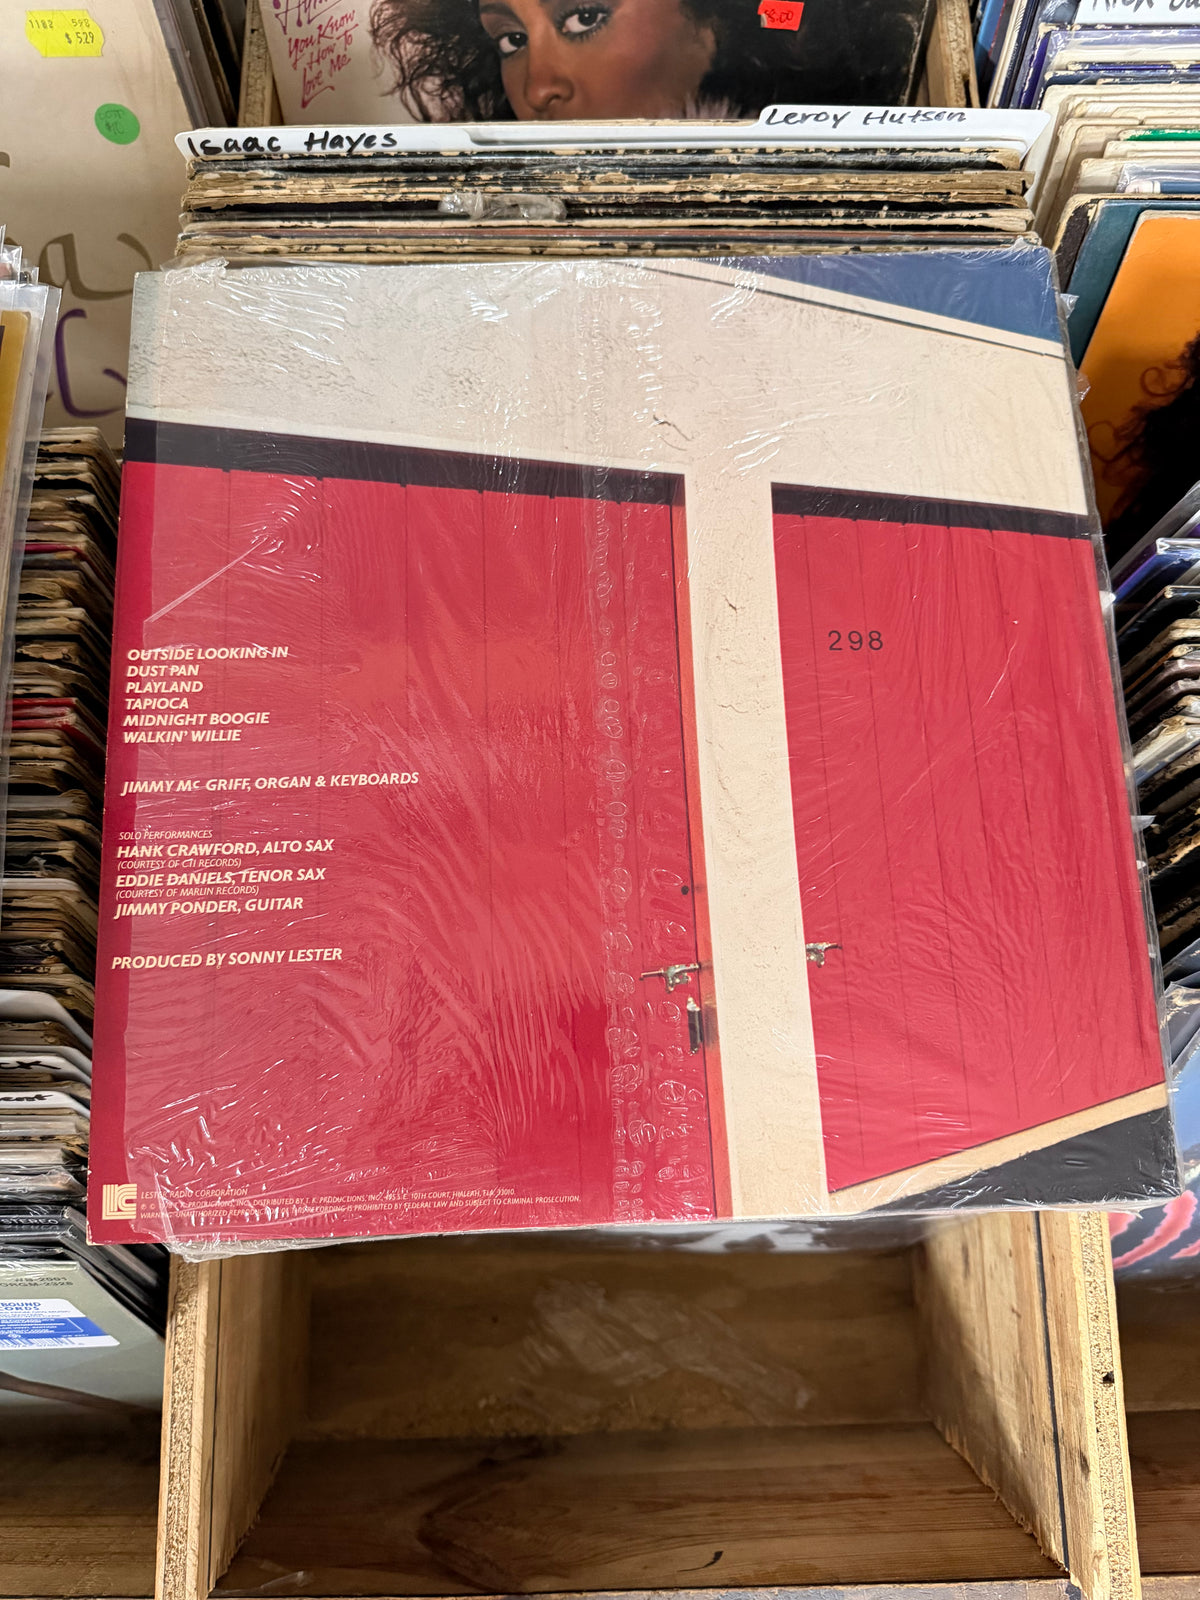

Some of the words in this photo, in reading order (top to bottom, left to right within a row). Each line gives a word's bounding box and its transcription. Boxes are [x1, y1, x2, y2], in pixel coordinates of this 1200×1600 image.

[317, 9, 355, 44] Know
[307, 43, 336, 71] How
[764, 108, 851, 128] Leroy
[863, 108, 967, 126] Hutson
[188, 134, 281, 157] Isaac
[304, 129, 397, 153] Hayes
[828, 630, 883, 651] 298
[127, 648, 195, 661] OUTSIDE
[197, 647, 268, 660] LOOKING
[271, 646, 289, 658] IN
[126, 665, 168, 678] DUST
[170, 664, 200, 677] PAN
[125, 681, 204, 694] PLAYLAND
[125, 697, 189, 710] TAPIOCA
[123, 713, 207, 727] MIDNIGHT
[209, 712, 270, 725] BOOGIE
[191, 729, 242, 742] WILLIE
[120, 781, 174, 796] JIMMY
[206, 777, 252, 792] GRIFF,
[254, 775, 312, 790] ORGAN
[314, 775, 327, 788] &
[330, 772, 419, 787] KEYBOARDS
[119, 830, 142, 841] SOLO
[143, 829, 213, 840] PERFORMANCES
[117, 845, 164, 858] HANK
[166, 842, 260, 857] CRAWFORD,
[262, 840, 304, 853] ALTO
[305, 839, 335, 852] SAX
[117, 859, 166, 871] (COURTESY
[170, 859, 180, 869] OF
[198, 858, 242, 869] RECORDS)
[116, 873, 164, 888] EDDIE
[166, 871, 235, 887] DANIELS,
[239, 869, 293, 883] TENOR
[296, 868, 326, 881] SAX
[116, 888, 164, 901] (COURTESY
[166, 888, 178, 897] OF
[180, 887, 214, 897] MARLIN
[216, 885, 259, 897] RECORDS)
[113, 902, 168, 919] JIMMY
[170, 900, 241, 915] PONDER,
[245, 898, 304, 911] GUITAR
[111, 955, 203, 970] PRODUCED
[205, 953, 225, 967] BY
[228, 950, 287, 965] SONNY
[288, 948, 342, 962] LESTER
[169, 1190, 193, 1199] RADIO
[195, 1188, 248, 1198] CORPORATION
[253, 1198, 294, 1207] DISTRIBUTED
[354, 1203, 393, 1211] PROHIBITED
[394, 1202, 402, 1210] BY
[404, 1201, 431, 1210] FEDERAL
[433, 1200, 448, 1209] LAW
[465, 1198, 491, 1207] SUBJECT
[493, 1198, 502, 1206] TO
[503, 1196, 534, 1205] CRIMINAL
[535, 1195, 581, 1204] PROSECUTION.
